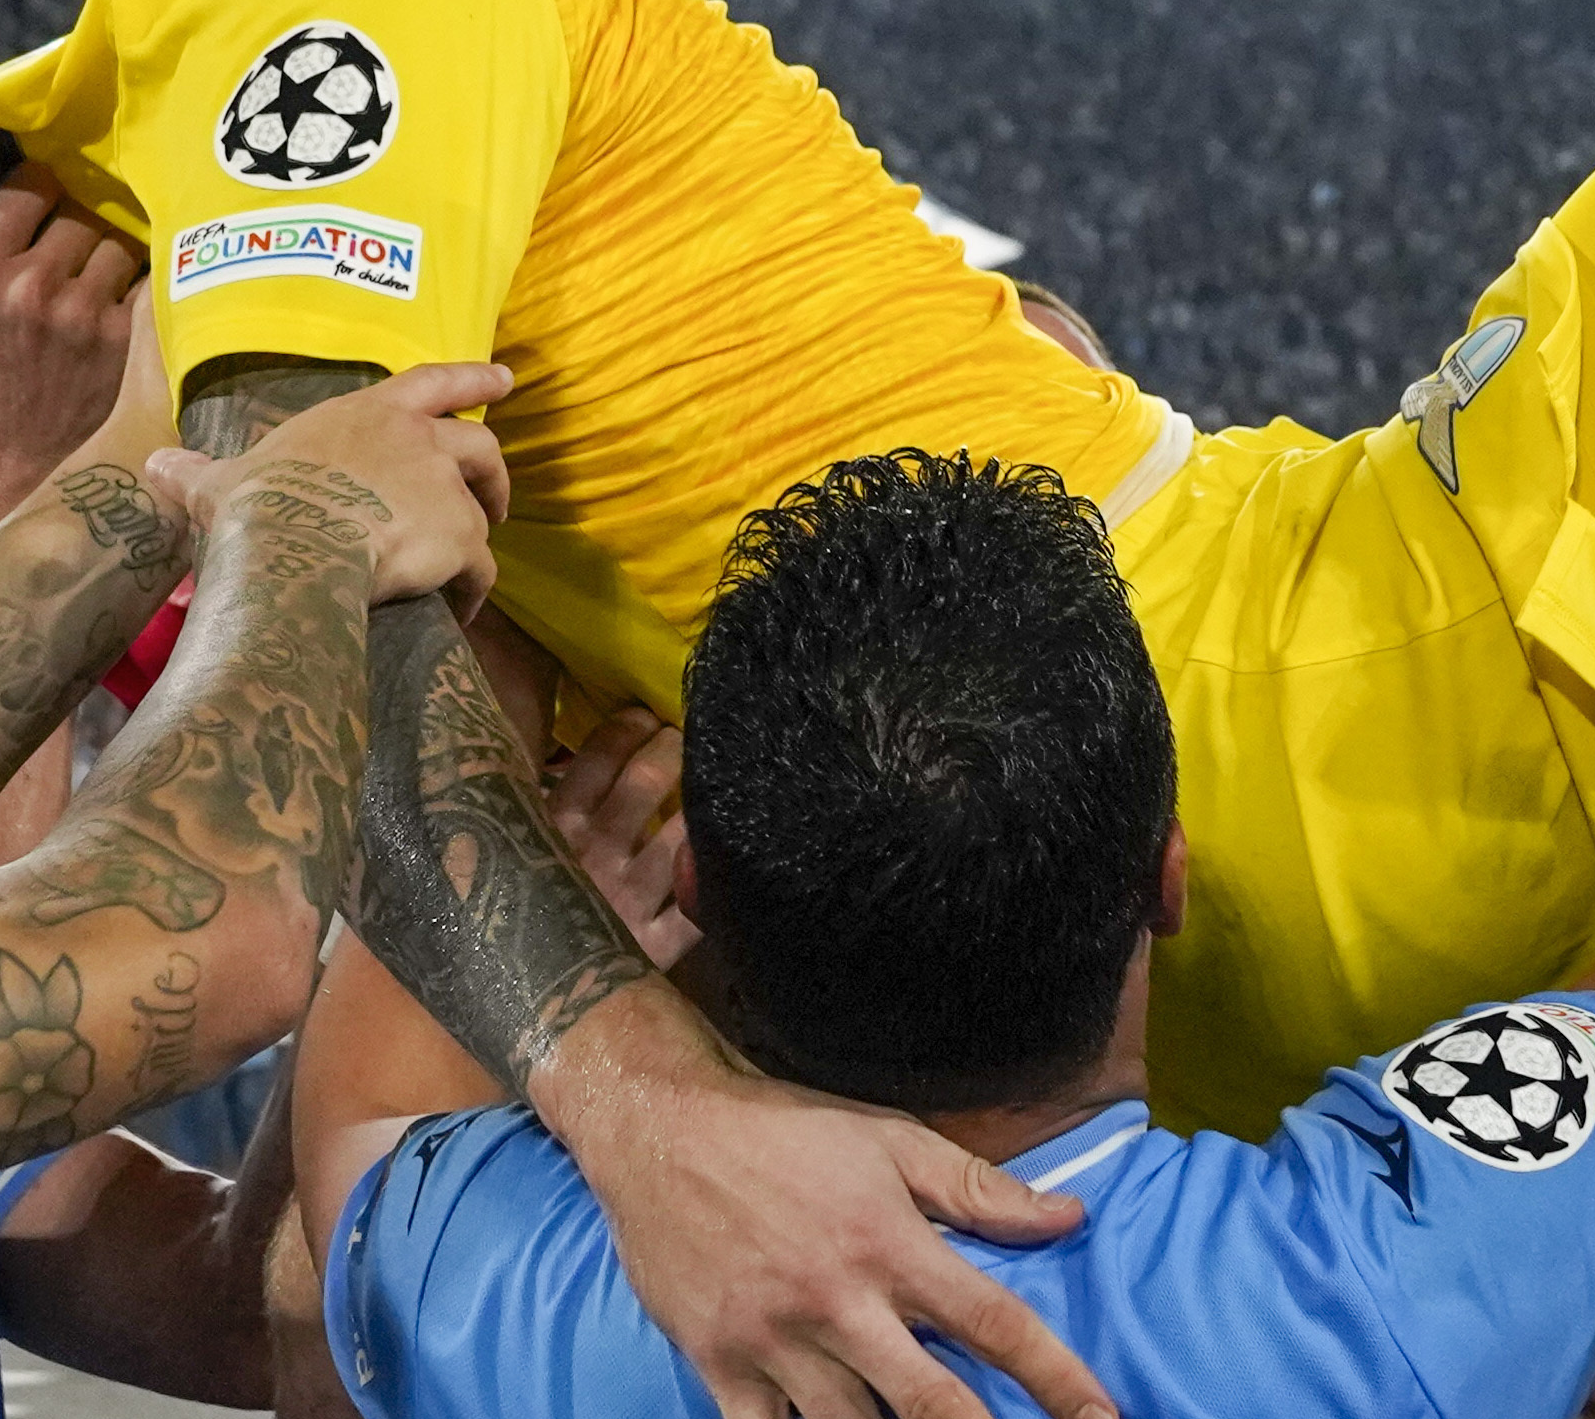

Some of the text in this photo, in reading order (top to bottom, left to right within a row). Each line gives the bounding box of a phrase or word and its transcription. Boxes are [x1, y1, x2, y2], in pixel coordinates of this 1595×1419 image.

[177, 227, 414, 275] FOUNDATION
[179, 222, 229, 249] UEFA
[333, 261, 409, 292] for children
